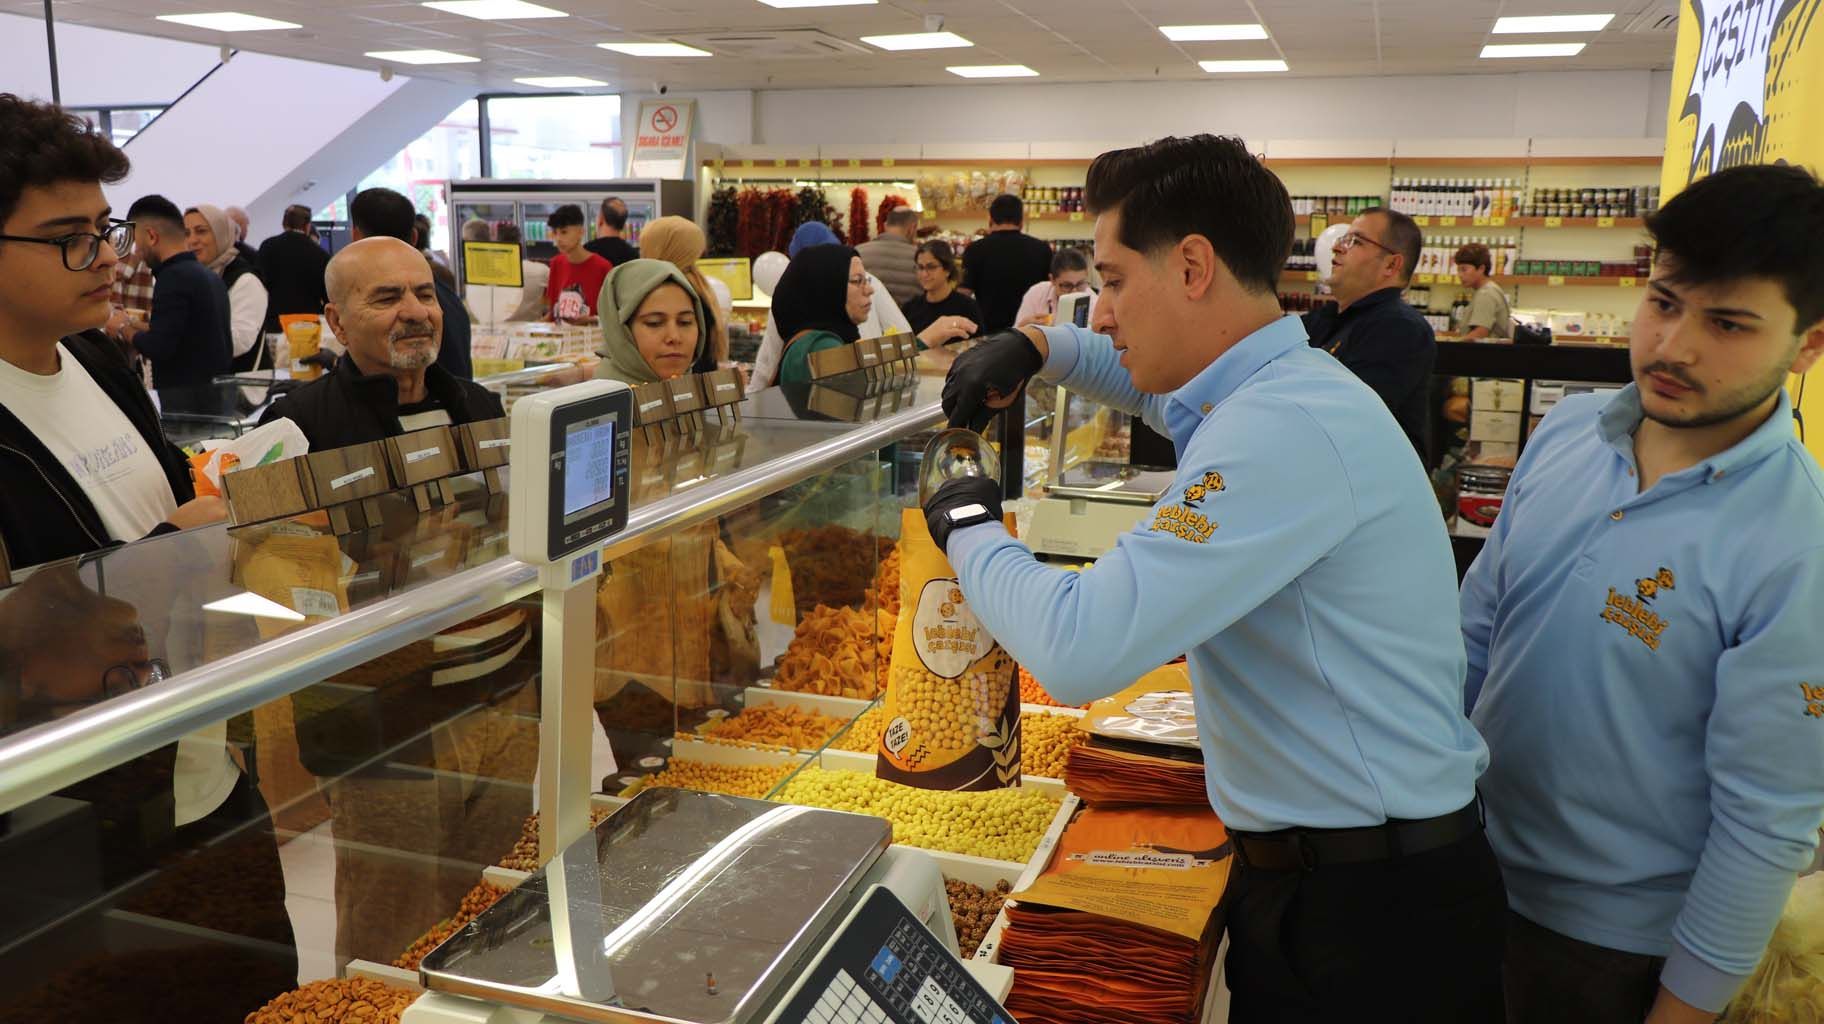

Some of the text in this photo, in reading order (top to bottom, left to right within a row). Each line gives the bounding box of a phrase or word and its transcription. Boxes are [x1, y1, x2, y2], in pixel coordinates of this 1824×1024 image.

[1606, 586, 1668, 636] leblebi
[889, 721, 904, 738] TAZE
[929, 983, 940, 995] 9
[923, 994, 934, 1006] 8
[917, 1004, 928, 1017] 7
[949, 1003, 960, 1015] 6
